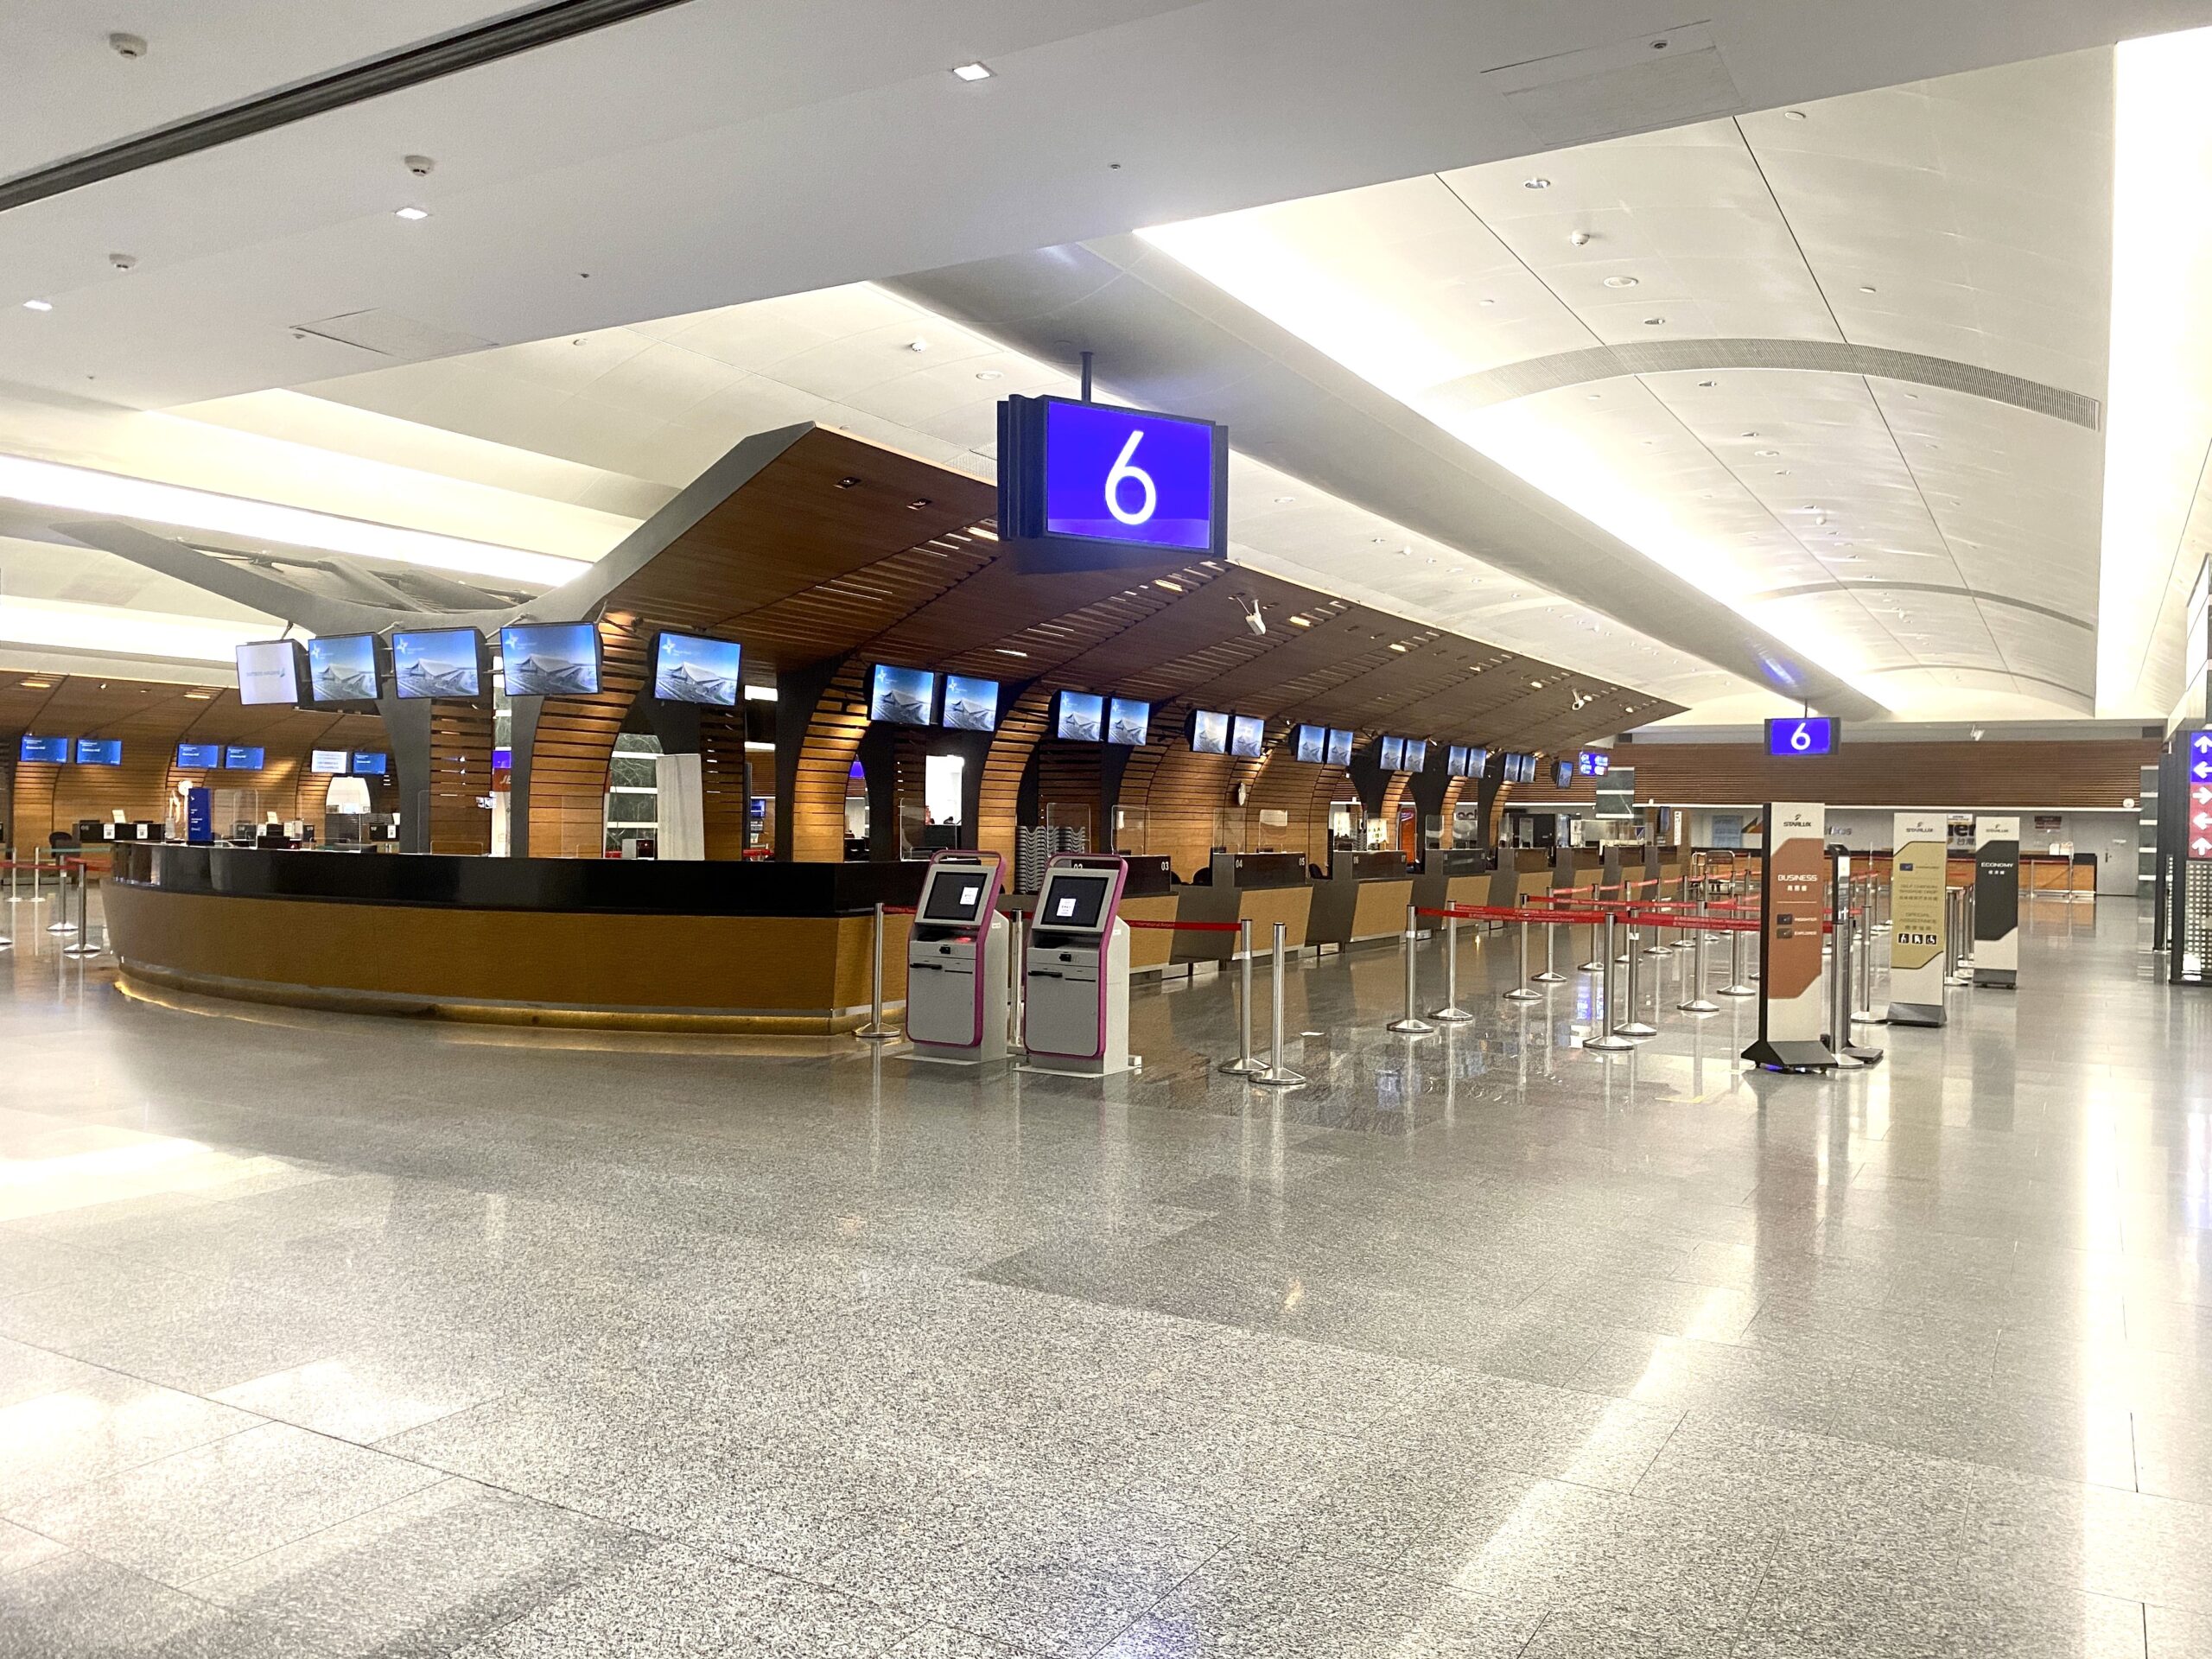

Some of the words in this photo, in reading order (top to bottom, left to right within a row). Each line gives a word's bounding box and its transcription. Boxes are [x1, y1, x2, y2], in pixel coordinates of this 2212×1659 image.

[1104, 429, 1157, 525] 6
[1790, 721, 1811, 750] 6
[1160, 861, 1169, 871] 03
[1235, 859, 1243, 868] 04
[1298, 858, 1306, 867] 05
